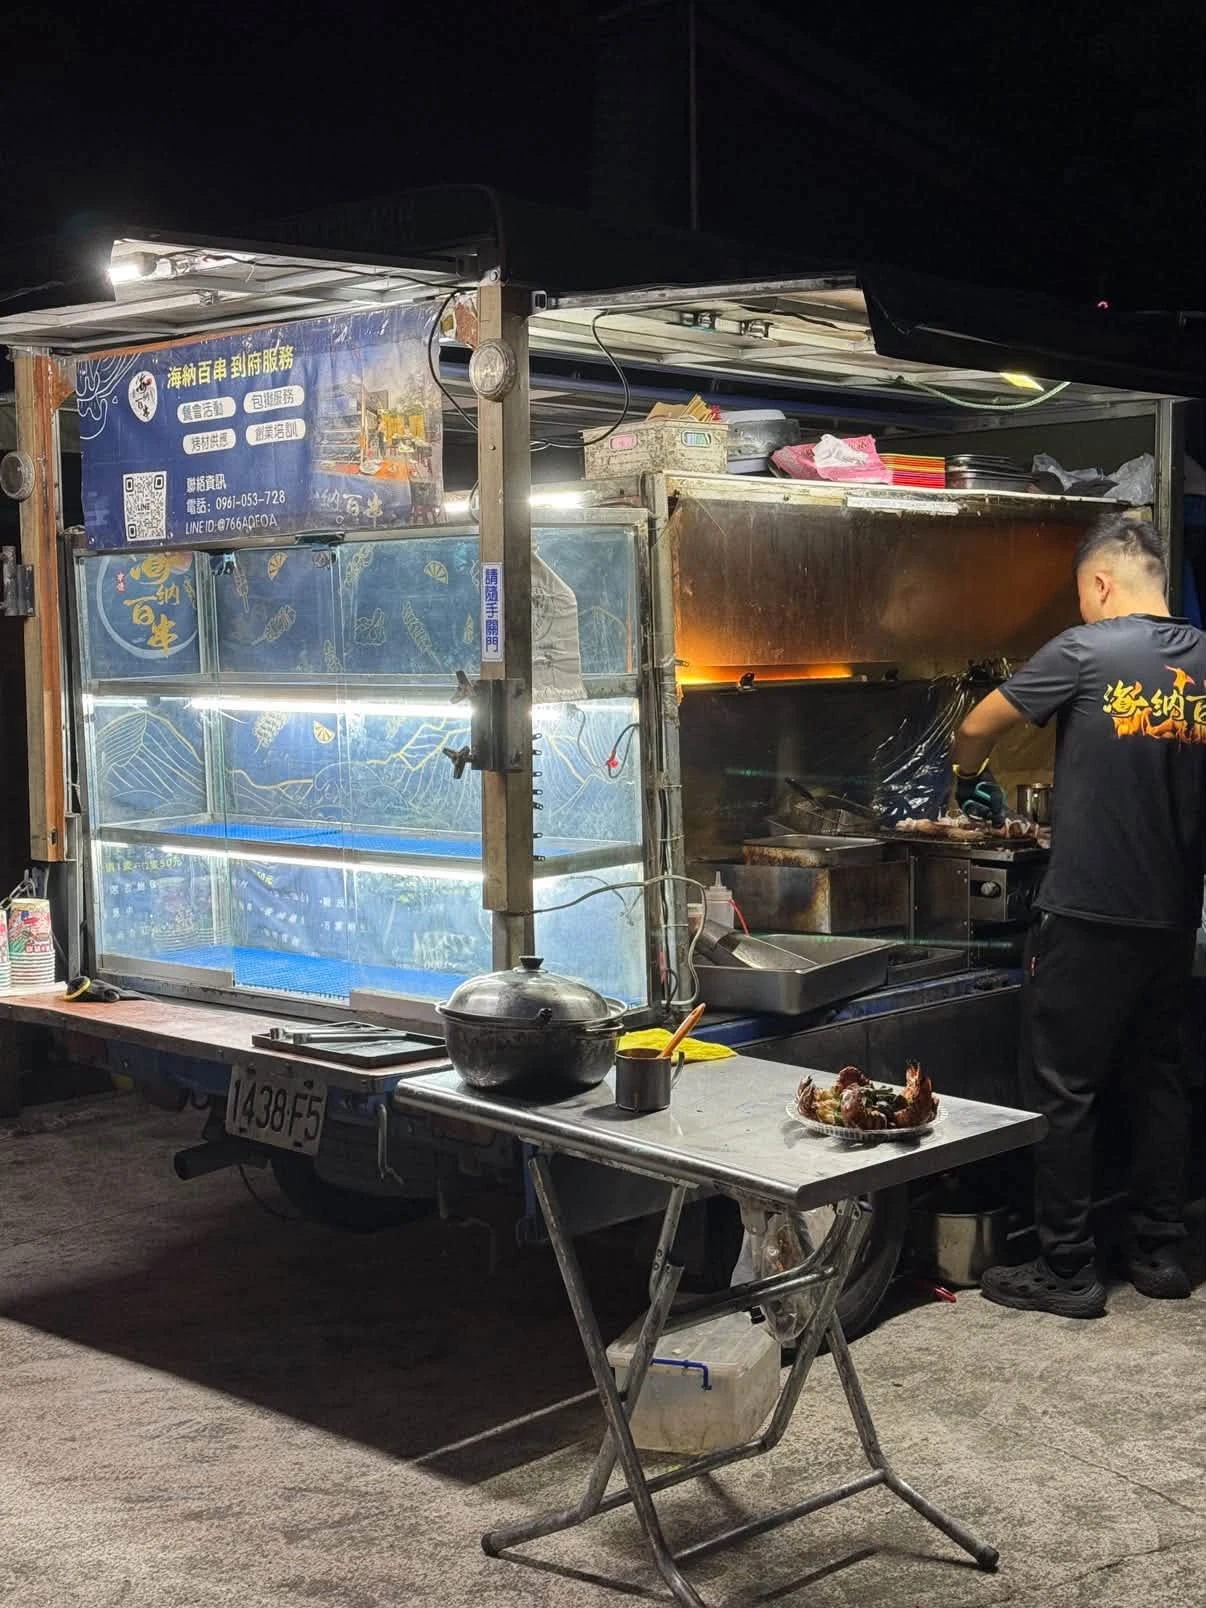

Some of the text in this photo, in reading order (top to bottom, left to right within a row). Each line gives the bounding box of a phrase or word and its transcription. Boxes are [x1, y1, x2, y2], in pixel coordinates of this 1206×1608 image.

[167, 345, 294, 389] 海納百串 到府服務
[191, 431, 229, 452] 烤材供應
[186, 473, 227, 493] 聯絡資訊
[215, 490, 286, 510] 0961-053-728
[311, 487, 384, 528] 納百串
[484, 568, 499, 653] 請隨手關門
